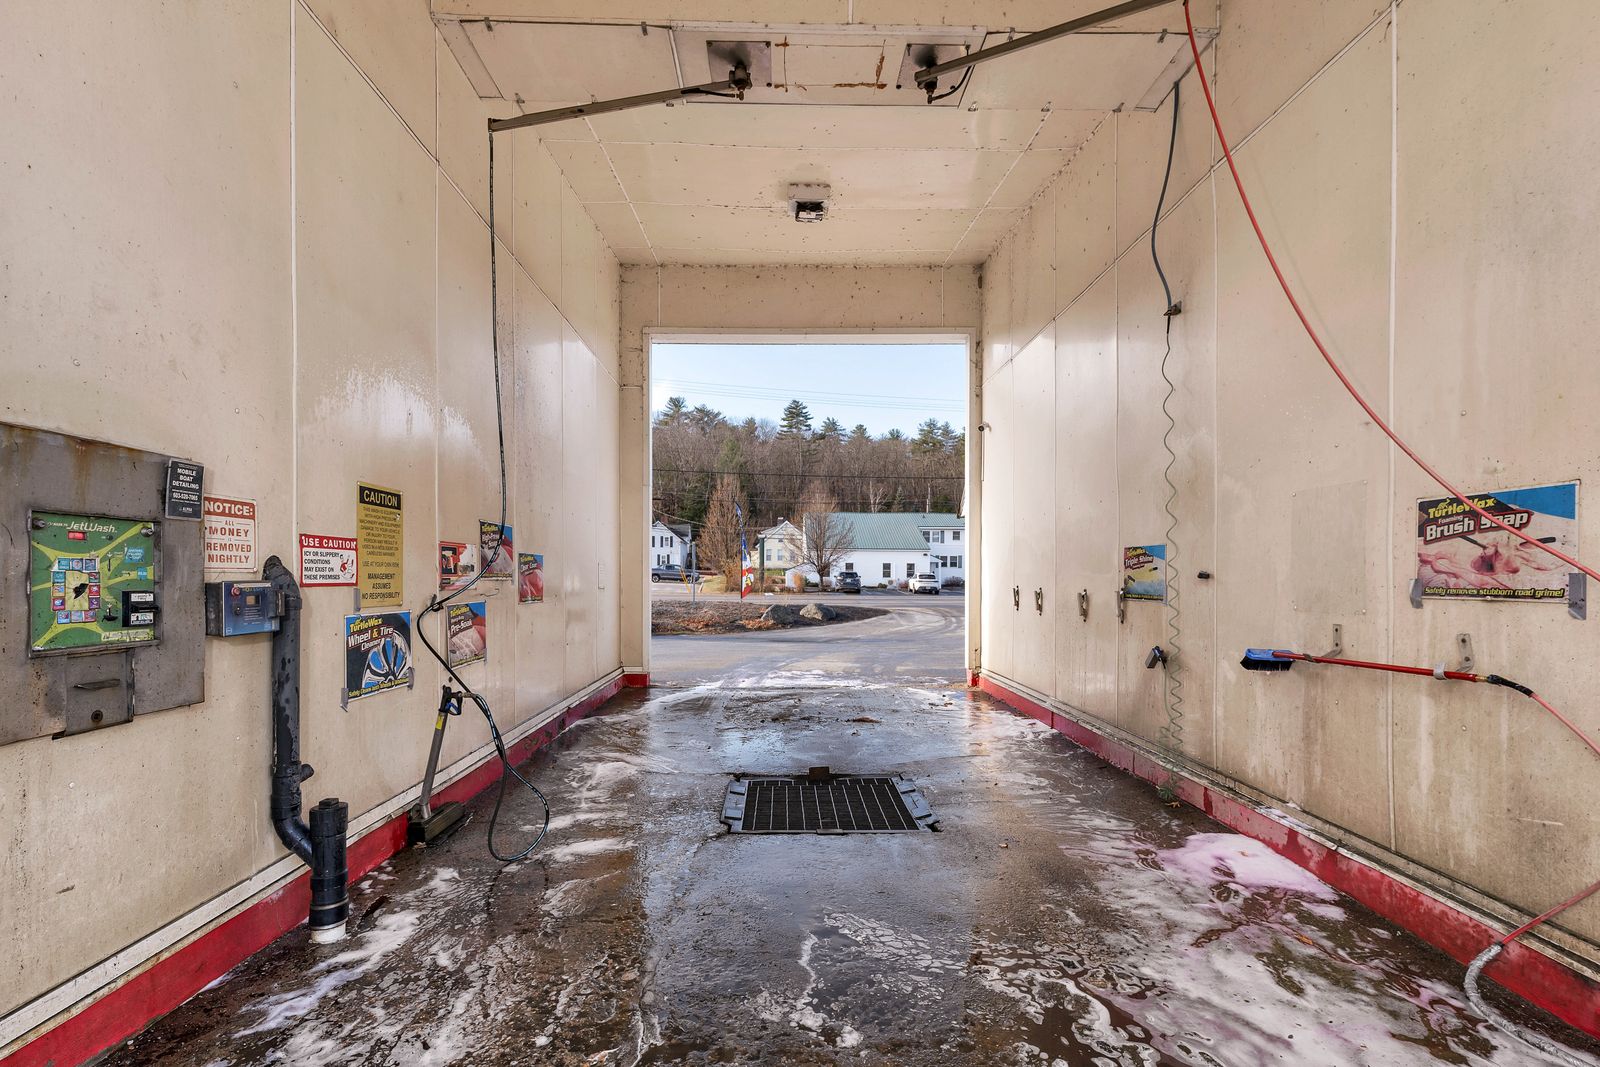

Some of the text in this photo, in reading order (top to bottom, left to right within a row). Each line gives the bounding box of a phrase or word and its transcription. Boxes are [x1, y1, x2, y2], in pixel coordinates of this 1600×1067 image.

[178, 468, 196, 476] MOBILE
[172, 481, 199, 489] DETAILING
[364, 490, 397, 507] CAUTION
[205, 501, 253, 516] NOTICE:
[209, 526, 249, 537] MONEY
[1426, 518, 1474, 540] Brush
[206, 542, 251, 552] REMOVED
[303, 538, 356, 549] USE CAUTION
[208, 554, 249, 563] NIGHTLY
[368, 591, 400, 599] RESPONSIBILITY
[1535, 589, 1564, 598] grime!
[348, 627, 394, 647] Wheel & Tire
[362, 639, 381, 650] Cleaner
